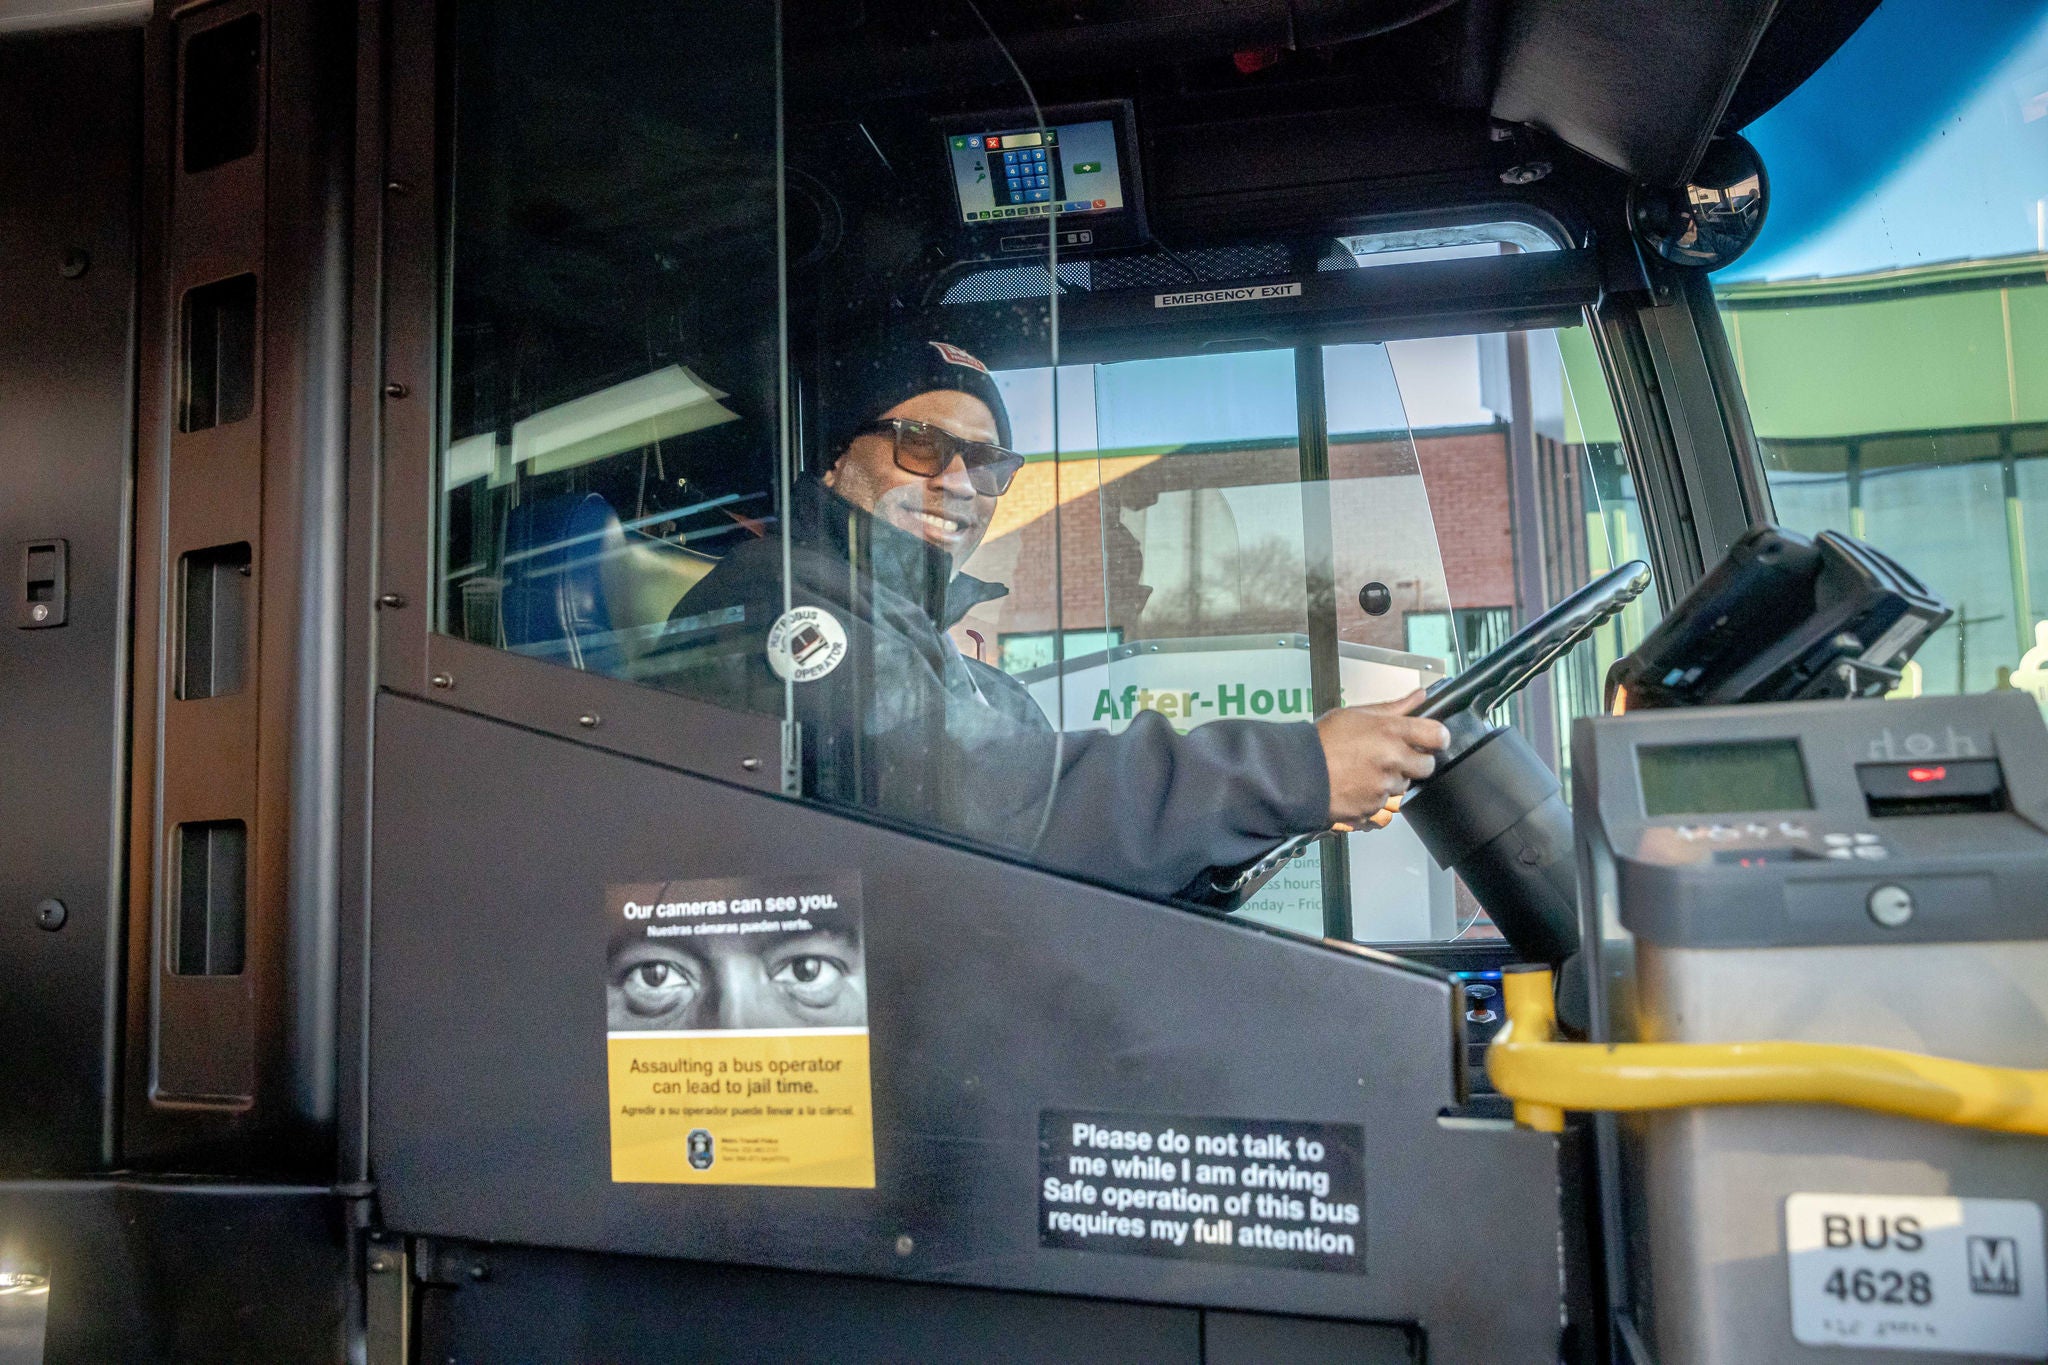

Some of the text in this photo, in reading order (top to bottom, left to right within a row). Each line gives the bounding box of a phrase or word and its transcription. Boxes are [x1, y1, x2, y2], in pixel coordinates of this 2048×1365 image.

[1162, 285, 1294, 305] EMERGENCY EXIT
[794, 642, 843, 679] OPERATOR
[1092, 683, 1346, 721] After-Hou
[624, 894, 838, 920] Our cameras can see you.
[1242, 898, 1285, 914] onday
[630, 1058, 843, 1076] Assaulting a bus operator
[652, 1078, 819, 1097] can lead to jail time.
[621, 1105, 656, 1117] Agredir
[682, 1105, 728, 1117] operador
[731, 1106, 763, 1117] puede
[1072, 1122, 1325, 1163] Please do not talk to
[1069, 1155, 1330, 1198] me while I am driving
[1043, 1177, 1360, 1225] Safe operation of this bus
[1048, 1210, 1355, 1255] requires my full attention
[1823, 1214, 1925, 1252] BUS
[1824, 1268, 1934, 1307] 4628
